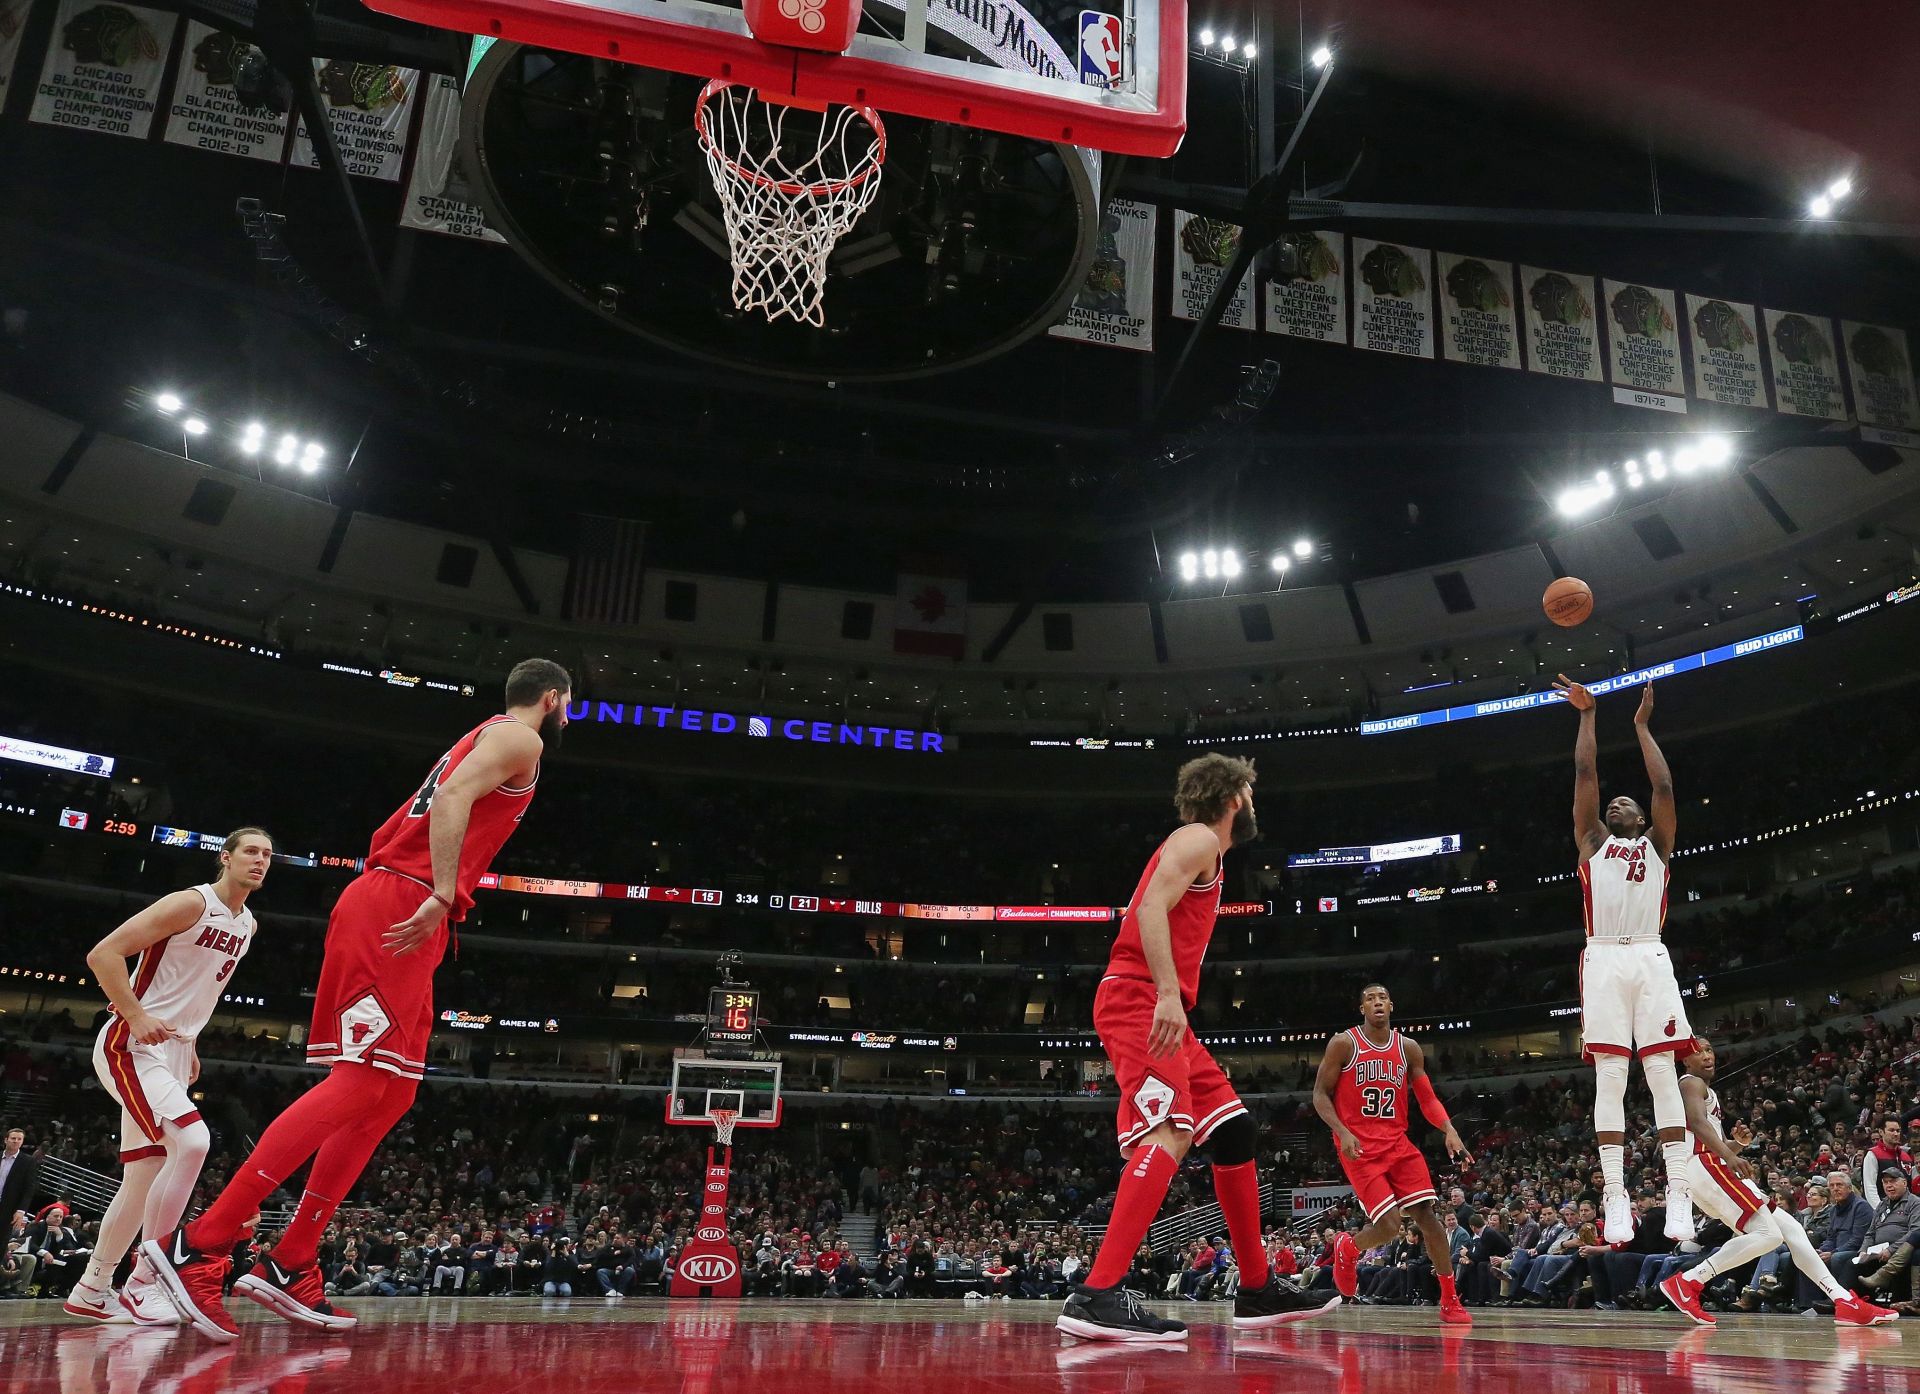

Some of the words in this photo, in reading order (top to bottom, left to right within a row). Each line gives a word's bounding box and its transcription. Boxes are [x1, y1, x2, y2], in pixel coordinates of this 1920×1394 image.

[74, 65, 132, 84] CHICAGO
[54, 75, 145, 98] BLACKHAWKS
[39, 84, 98, 103] CENTRAL
[102, 95, 154, 112] DIVISION
[55, 100, 132, 120] CHAMPIONS
[329, 108, 382, 126] CHICAGO
[52, 112, 129, 133] 2009-2010
[172, 106, 230, 125] CENTRAL
[234, 117, 285, 135] DIVISION
[188, 122, 264, 144] CHAMPIONS
[199, 137, 249, 154] 2012-13
[355, 139, 403, 154] DIVISION
[418, 196, 482, 215] STANLEY
[448, 223, 482, 236] 1934
[1274, 288, 1337, 304] BLACKHAWKS
[1374, 297, 1412, 310] CHICAGO
[1283, 298, 1329, 312] WESTERN
[1363, 304, 1424, 320] BLACKHAWKS
[1119, 316, 1144, 327] CUP
[1275, 305, 1336, 323] CONFERENCE
[1371, 315, 1416, 328] WESTERN
[1461, 310, 1498, 322] CHICAGO
[1065, 317, 1139, 337] CHAMPIONS
[1280, 315, 1333, 331] CHAMPIONS
[1363, 322, 1424, 338] CONFERENCE
[1451, 317, 1510, 332] BLACKHAWKS
[1544, 322, 1580, 335] CHICAGO
[1088, 330, 1116, 343] 2015
[1289, 326, 1324, 339] 2012-13
[1368, 332, 1420, 346] CHAMPIONS
[1459, 327, 1506, 340] CAMPBELL
[1534, 329, 1591, 345] BLACKHAWKS
[1368, 341, 1420, 355] 2009-2010
[1454, 335, 1511, 350] CONFERENCE
[1540, 339, 1587, 353] CAMPBELL
[1627, 335, 1662, 348] CHICAGO
[1458, 344, 1508, 358] CHAMPIONS
[1536, 346, 1592, 362] CONFERENCE
[1617, 342, 1673, 357] BLACKHAWKS
[1710, 349, 1744, 362] CHICAGO
[1467, 354, 1500, 366] 1991-92
[1541, 356, 1589, 370] CHAMPIONS
[1623, 351, 1668, 365] CAMPBELL
[1701, 355, 1756, 371] BLACKHAWKS
[1548, 366, 1584, 377] 1972-73
[1620, 358, 1675, 374] CONFERENCE
[1717, 367, 1743, 378] WALES
[1624, 367, 1671, 382] CHAMPIONS
[1704, 374, 1757, 388] CONFERENCE
[1633, 378, 1664, 389] 1970-71
[1708, 383, 1755, 396] CHAMPIONS
[1635, 394, 1665, 407] 1971-72
[1837, 606, 1869, 622] STREAMING
[1870, 602, 1880, 610] ALL
[42, 594, 72, 606] LIVE
[82, 604, 134, 622] BEFORE
[156, 624, 196, 638] AFTER
[204, 635, 242, 649] EVERY
[250, 646, 281, 659] GAME
[1736, 639, 1761, 655] BUD
[1762, 628, 1800, 646] LIGHT
[322, 663, 360, 674] STREAMING
[426, 682, 448, 690] GAMES
[387, 678, 414, 688] CHICAGO
[1478, 704, 1501, 715] BUD
[1502, 696, 1536, 709] LIGHT
[1613, 664, 1675, 689] LOUNGE
[567, 700, 737, 732] UNITED
[784, 720, 944, 752] CENTER
[1363, 723, 1386, 733] BUD
[1387, 715, 1419, 730] LIGHT
[1288, 728, 1338, 737] POSTGAME
[104, 820, 137, 836] 2:59
[1722, 838, 1748, 848] LIVE
[1757, 824, 1798, 841] BEFORE
[1818, 809, 1852, 824] AFTER
[1860, 796, 1897, 812] EVERY
[200, 842, 222, 852] UTAH
[1604, 842, 1647, 862] HEAT
[322, 856, 340, 866] 8:00
[342, 860, 355, 868] PM
[1626, 861, 1646, 883] 13
[627, 886, 650, 899] HEAT
[702, 892, 713, 901] 15
[736, 894, 758, 903] 3:34
[798, 899, 810, 908] 21
[855, 900, 882, 914] BULLS
[1357, 896, 1389, 905] STREAMING
[999, 909, 1046, 917] Budweiser
[1246, 905, 1264, 913] PTS
[195, 926, 247, 957] HEAT
[216, 959, 236, 982] 9
[0, 967, 67, 983] BEFORE
[224, 994, 264, 1005] GAME
[1681, 988, 1692, 997] ON
[725, 994, 752, 1008] 3:34
[457, 1011, 492, 1023] Sports
[727, 1008, 747, 1029] 16
[789, 1033, 829, 1041] STREAMING
[865, 1032, 897, 1043] Sports
[1281, 1032, 1327, 1042] BEFORE
[1393, 1024, 1431, 1033] EVERY
[1439, 1020, 1471, 1030] GAME
[1356, 1059, 1404, 1089] BULLS
[1361, 1087, 1395, 1118] 32
[702, 1230, 720, 1238] KIA
[690, 1261, 726, 1276] KIA
